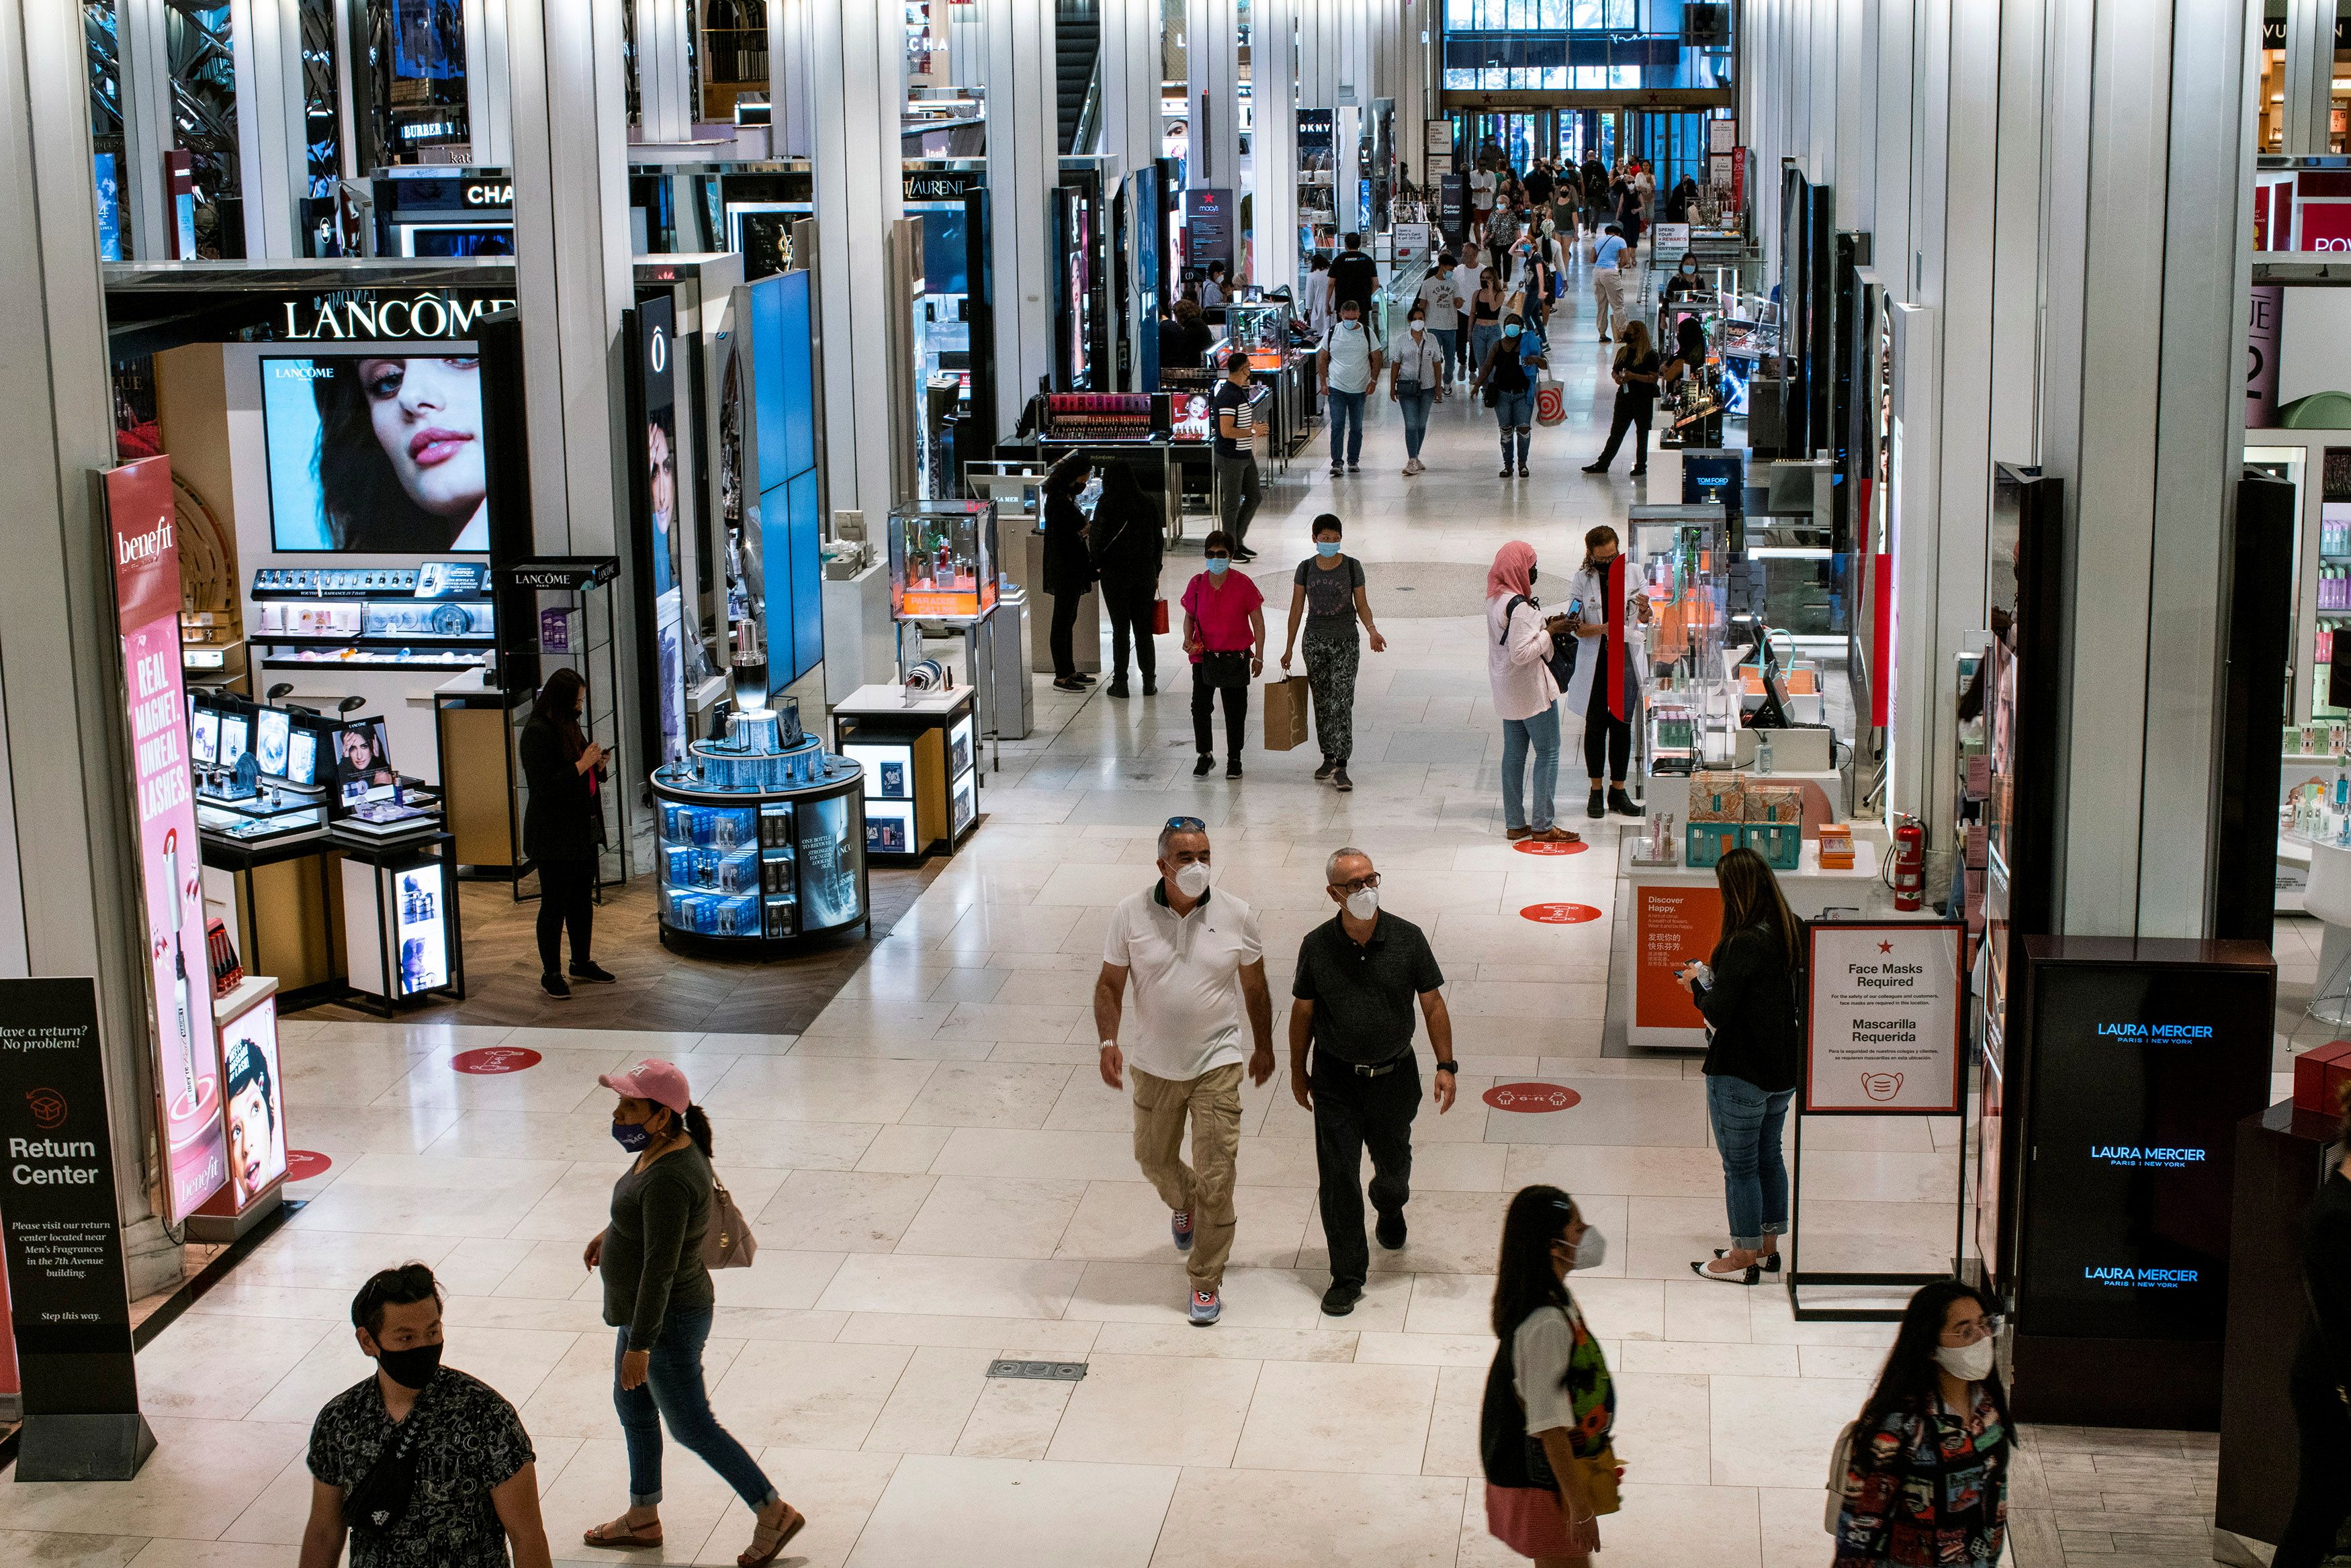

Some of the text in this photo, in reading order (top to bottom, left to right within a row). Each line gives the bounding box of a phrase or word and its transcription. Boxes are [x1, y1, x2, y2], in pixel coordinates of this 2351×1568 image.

[1300, 123, 1331, 132] DKNY
[468, 185, 513, 203] CHA
[1433, 285, 1454, 295] TOMMY
[275, 367, 334, 379] LANCÔME
[118, 516, 173, 565] benefit
[516, 573, 570, 584] LANCÔME
[911, 596, 957, 604] PARADISE
[137, 651, 169, 698] REAL
[134, 690, 181, 739] MAGNET.
[140, 729, 180, 778] UNREAL
[140, 764, 189, 823] LASHES.
[811, 840, 832, 848] RECOVER
[1648, 905, 1676, 913] Happy.
[1648, 933, 1681, 941] 发现你的
[1648, 942, 1683, 951] 快乐芬芳。
[1849, 964, 1923, 974] Face Masks
[1857, 976, 1914, 988] Required
[1853, 1019, 1916, 1029] Mascarilla
[2098, 1023, 2213, 1037] LAURA MERCIER
[28, 1029, 37, 1037] a
[40, 1025, 88, 1036] return?
[1852, 1031, 1916, 1044] Requerida
[3, 1038, 80, 1052] No problem!
[9, 1138, 95, 1158] Return
[2092, 1146, 2205, 1160] LAURA MERCIER
[12, 1164, 99, 1185] Center
[181, 1156, 218, 1203] benefit
[42, 1221, 61, 1230] visit
[49, 1233, 83, 1242] located
[25, 1246, 103, 1256] Men's Fragrances
[27, 1258, 36, 1266] in
[38, 1257, 53, 1265] the
[54, 1257, 69, 1265] 7th
[46, 1269, 87, 1279] building.
[2086, 1266, 2198, 1282] LAURA MERCIER
[41, 1311, 101, 1322] Step this way.
